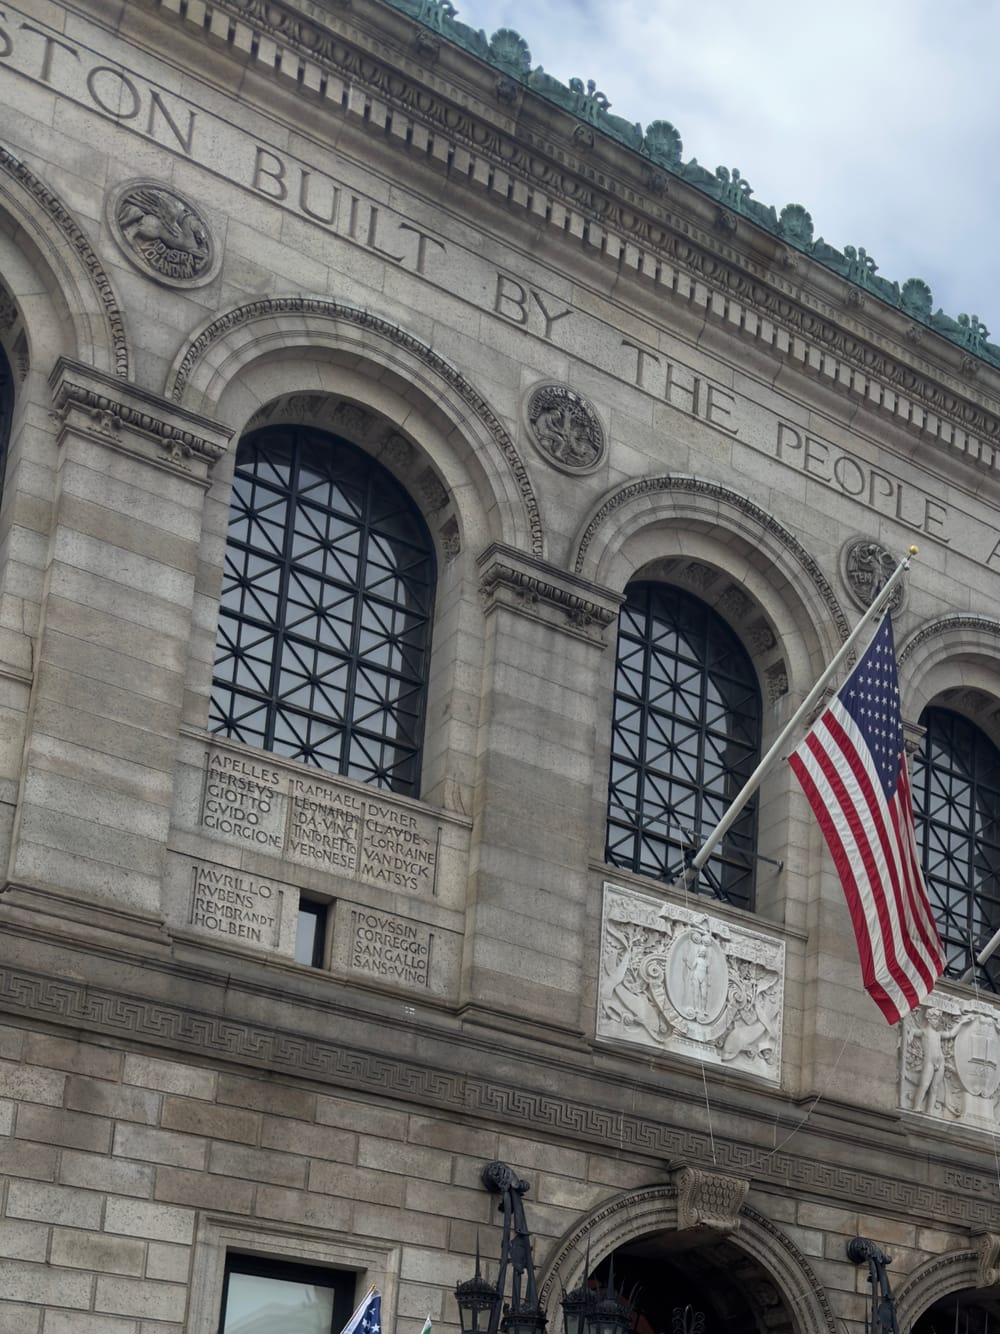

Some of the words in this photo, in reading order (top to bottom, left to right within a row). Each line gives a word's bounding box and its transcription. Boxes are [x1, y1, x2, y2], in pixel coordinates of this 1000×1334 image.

[250, 146, 447, 274] BUILT
[494, 272, 574, 339] BY
[621, 340, 739, 435] THE
[775, 421, 951, 544] PEOPLE
[209, 768, 274, 799] PERSEVS
[211, 754, 280, 785] APELLES
[207, 784, 271, 813] GIOTTO
[294, 795, 361, 824] LEONARDO
[295, 780, 360, 810] RAPHAEL
[206, 799, 259, 825] GVIDO
[368, 804, 417, 829] DVRER
[203, 815, 282, 848] GIORGIONE
[292, 824, 357, 855] TINTORETTO
[290, 840, 355, 869] VERONESE
[199, 868, 272, 899] MVRILLO
[362, 863, 418, 890] MATSYS
[197, 882, 254, 909] RVBENS
[195, 897, 274, 927] REMBRANDT
[358, 912, 417, 939] POVSSIN
[194, 912, 261, 942] HOLBEIN
[356, 927, 427, 955] CORREGGIO
[353, 955, 425, 984] SANSOVINO
